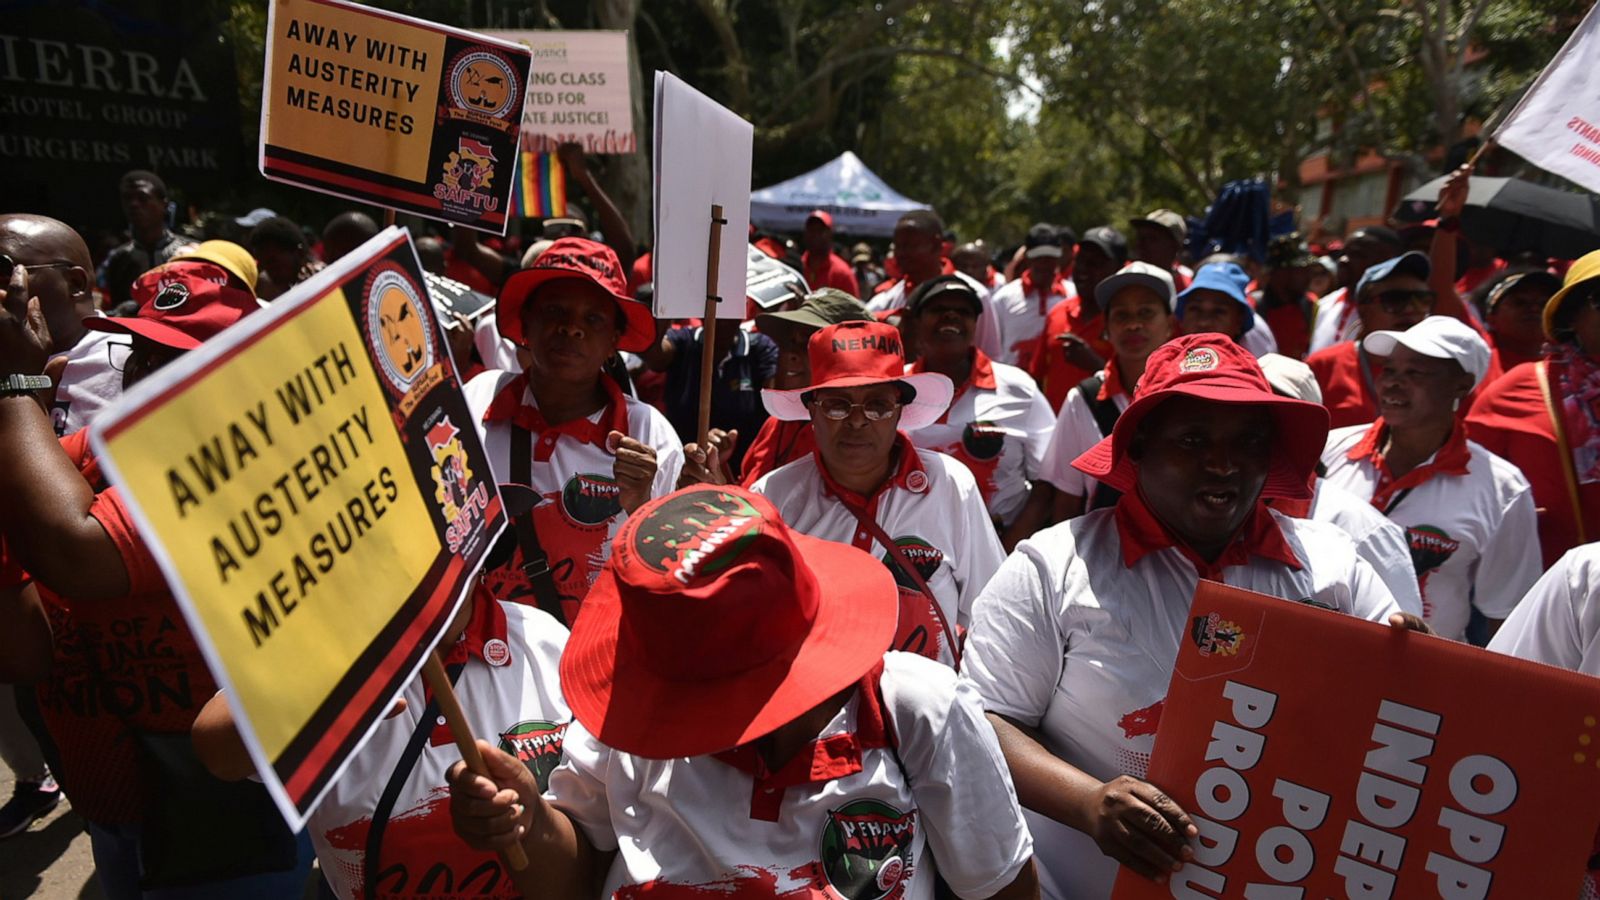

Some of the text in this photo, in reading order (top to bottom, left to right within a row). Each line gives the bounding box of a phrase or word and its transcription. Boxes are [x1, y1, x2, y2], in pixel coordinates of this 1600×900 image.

[286, 19, 427, 72] AWAY WITH
[288, 54, 419, 103] AUSTERITY
[529, 72, 606, 86] ING CLASS
[557, 92, 585, 105] FOR
[102, 103, 188, 129] GROUP
[287, 86, 414, 135] MEASURES
[551, 111, 609, 125] JUSTICE!
[147, 144, 220, 170] PARK
[433, 183, 498, 211] SAFTU
[164, 342, 358, 519] AWAY WITH
[208, 406, 376, 584] AUSTERITY
[445, 480, 489, 553] SAFTU
[240, 466, 400, 649] MEASURES
[674, 515, 752, 584] NEHAWU
[1244, 778, 1332, 900] PO
